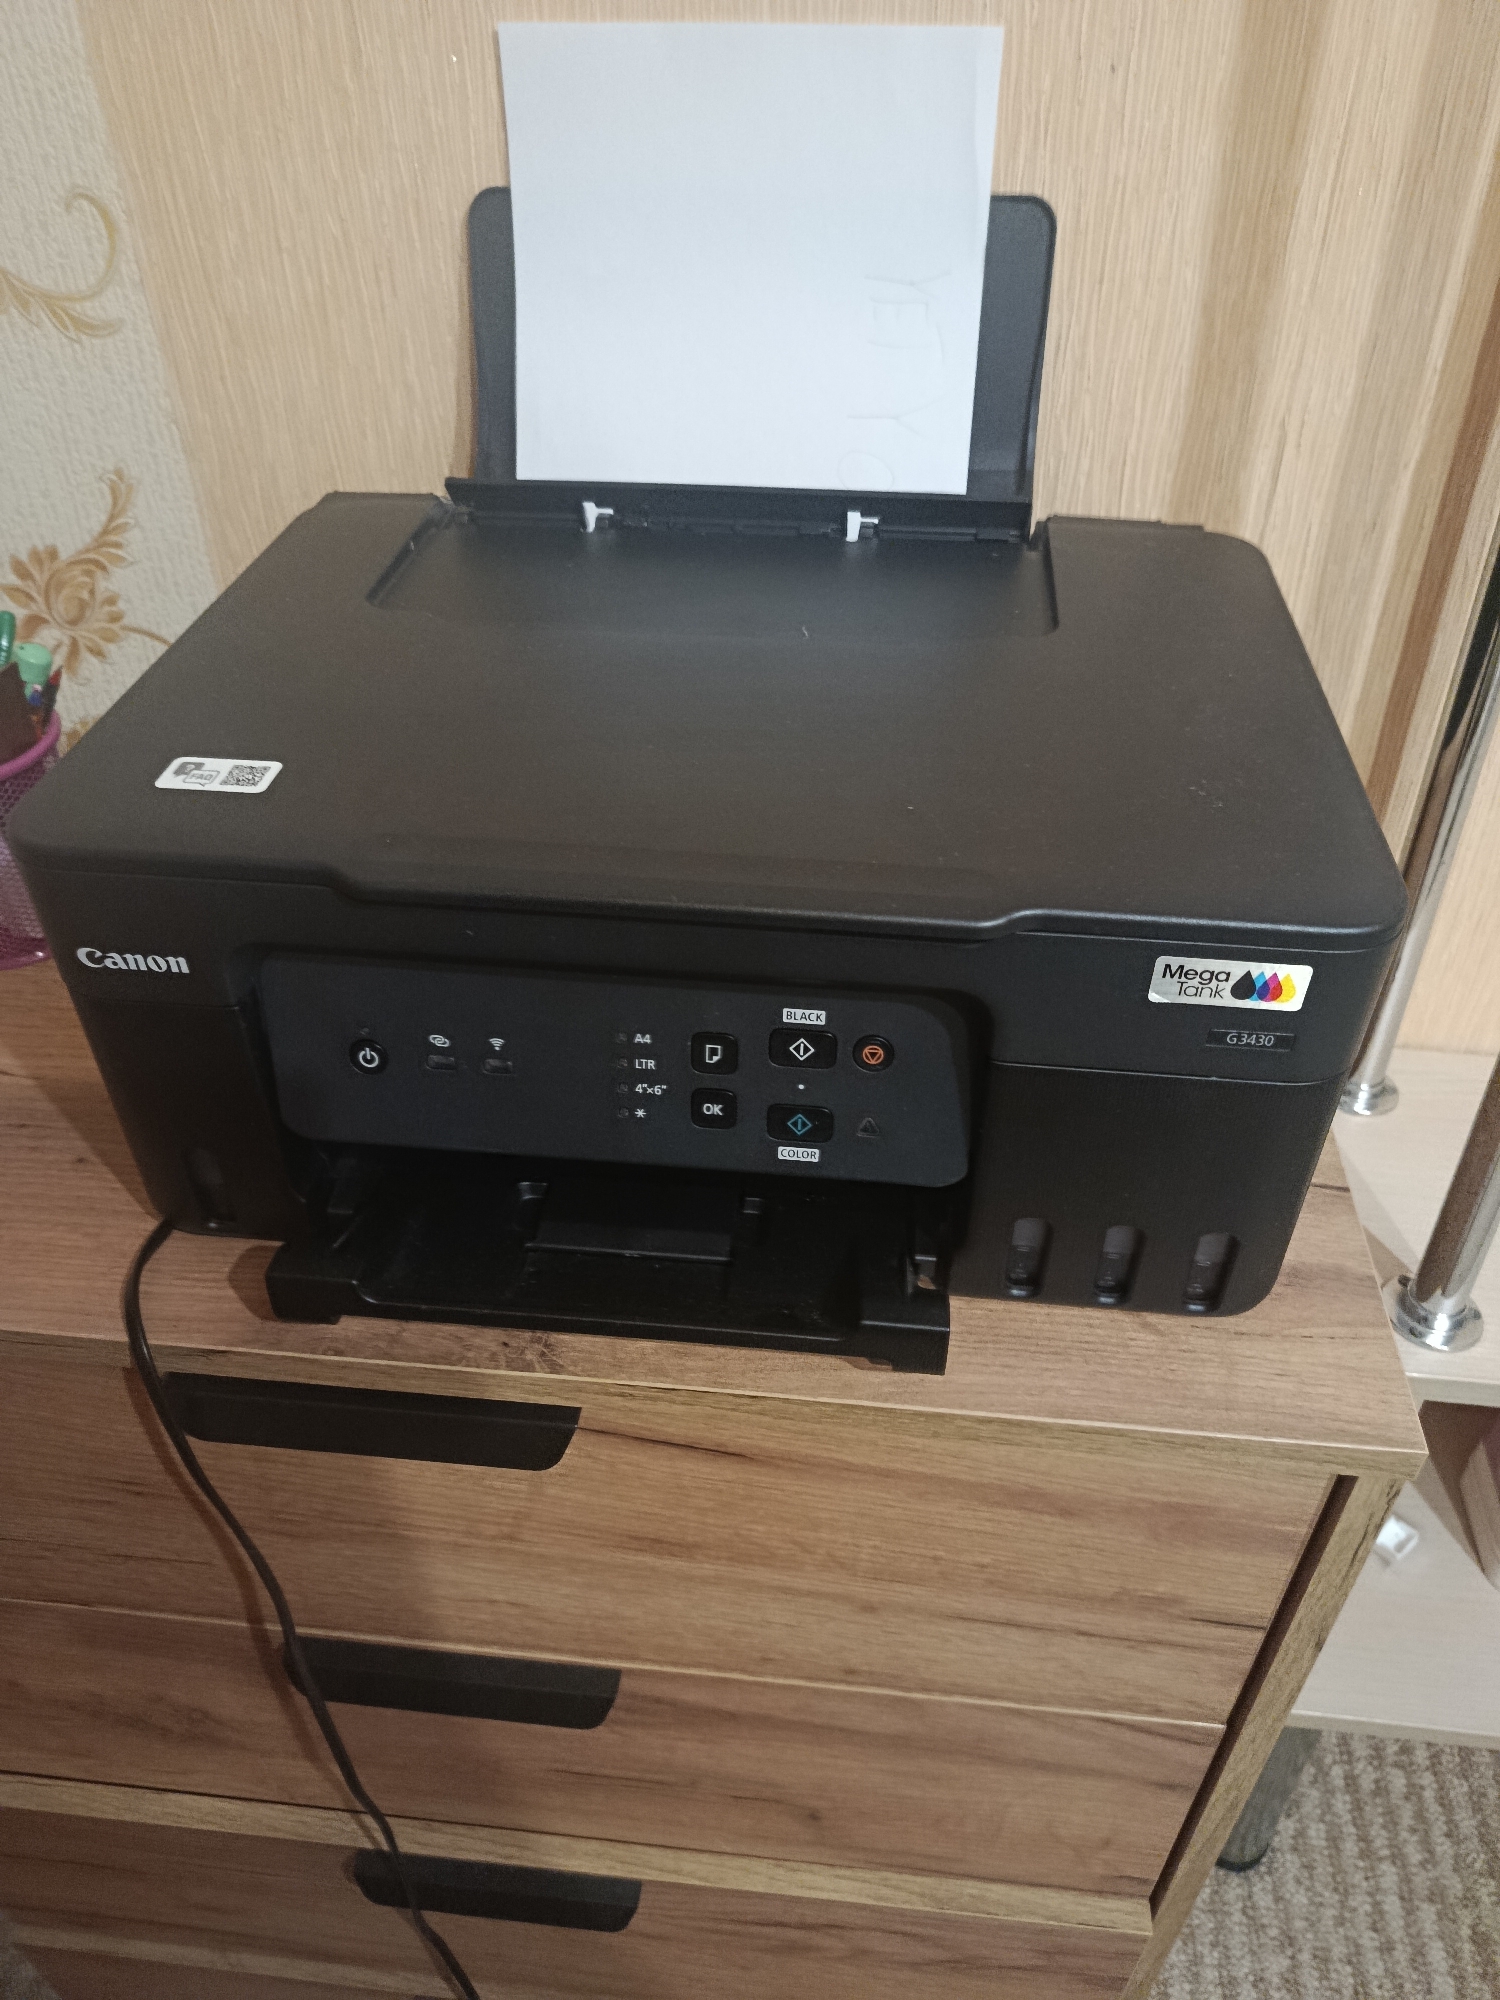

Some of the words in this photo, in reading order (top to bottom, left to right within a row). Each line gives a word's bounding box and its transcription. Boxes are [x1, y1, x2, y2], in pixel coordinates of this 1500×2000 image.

[76, 947, 190, 974] Canon
[1162, 964, 1231, 985] Mega
[1177, 981, 1226, 999] Tank
[786, 1010, 823, 1022] BLACK
[634, 1033, 652, 1044] A4
[1226, 1032, 1275, 1047] G3430
[635, 1059, 656, 1070] LTR
[703, 1103, 724, 1116] OK
[780, 1148, 817, 1160] COLOR
